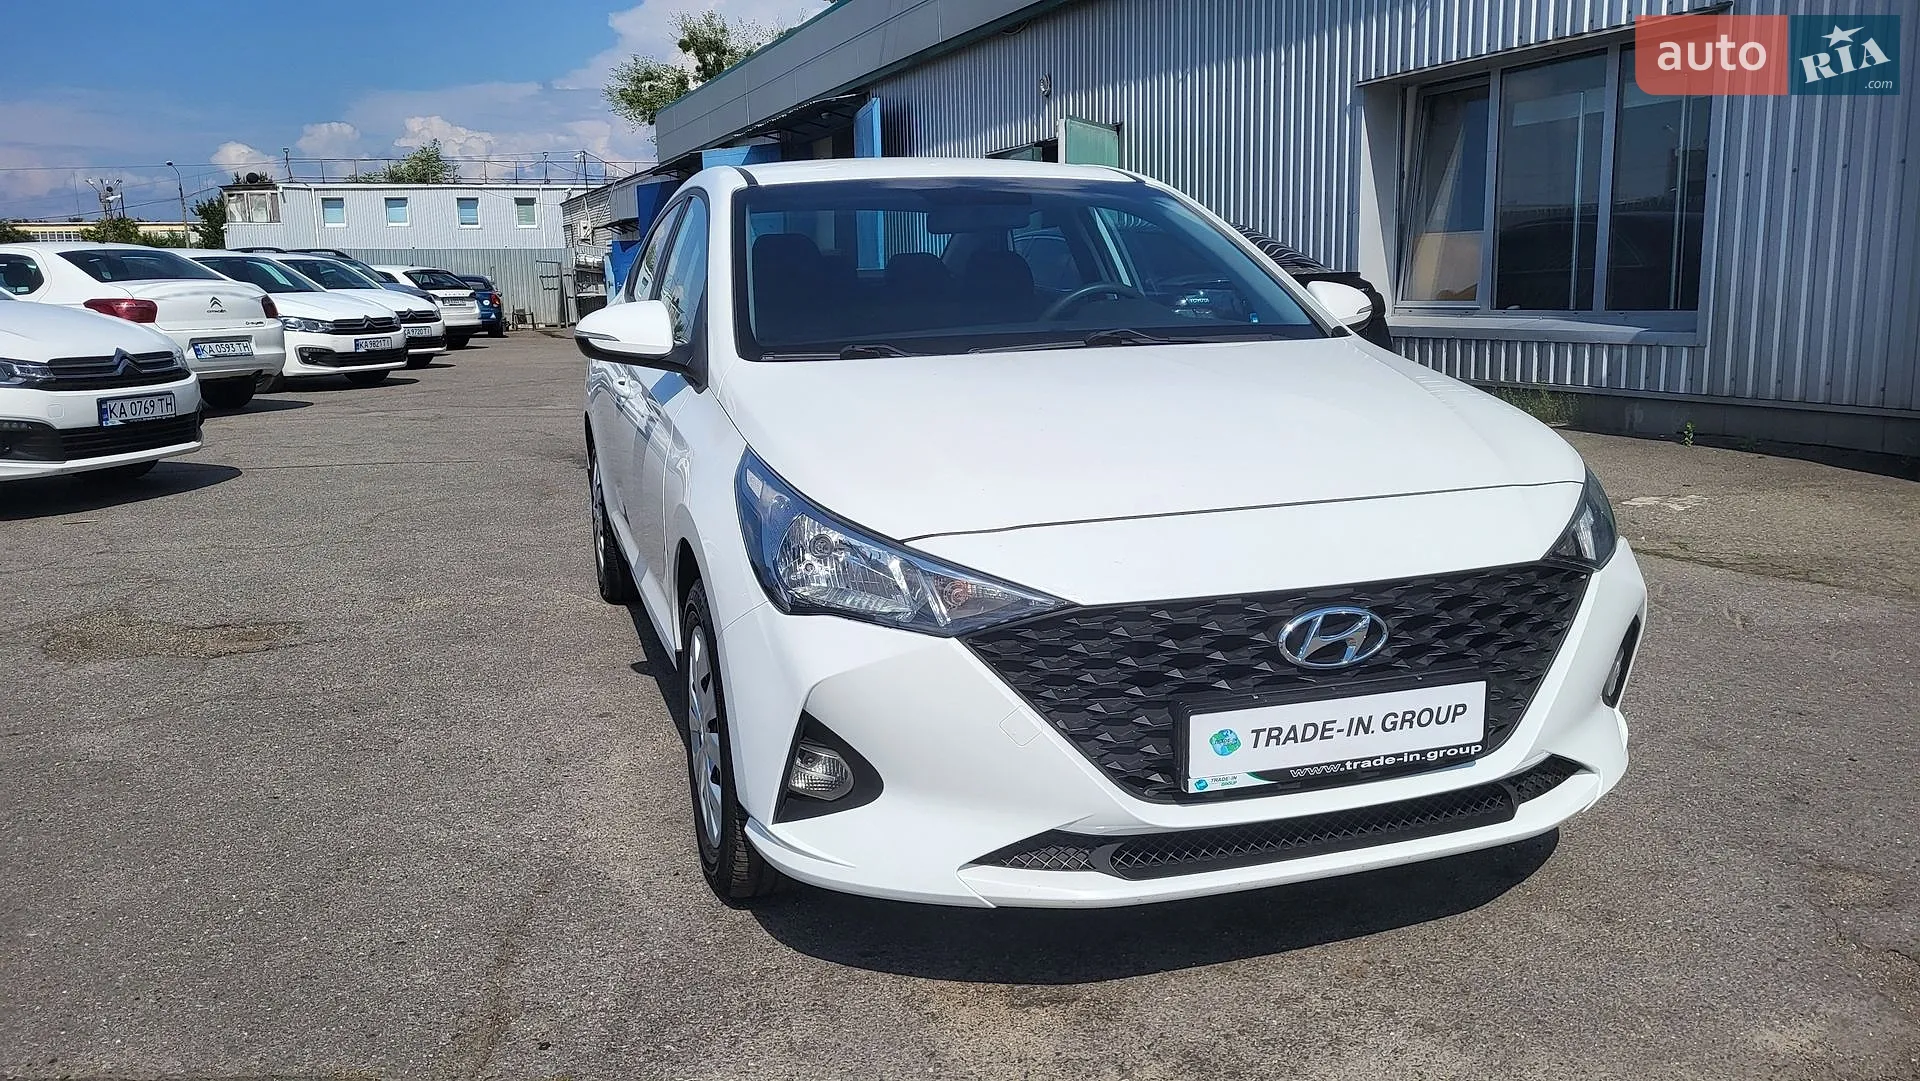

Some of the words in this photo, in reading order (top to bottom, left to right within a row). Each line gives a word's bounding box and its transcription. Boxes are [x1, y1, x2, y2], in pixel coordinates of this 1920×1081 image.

[200, 344, 215, 354] KA
[216, 343, 236, 353] 0593
[236, 343, 250, 352] TH
[360, 340, 369, 348] KA
[108, 402, 128, 418] KA
[130, 400, 155, 416] 0769
[158, 396, 173, 413] TH
[1250, 715, 1375, 749] TRADE-IN.
[1381, 703, 1467, 733] GROUP
[1290, 743, 1483, 777] www.trade-in.group
